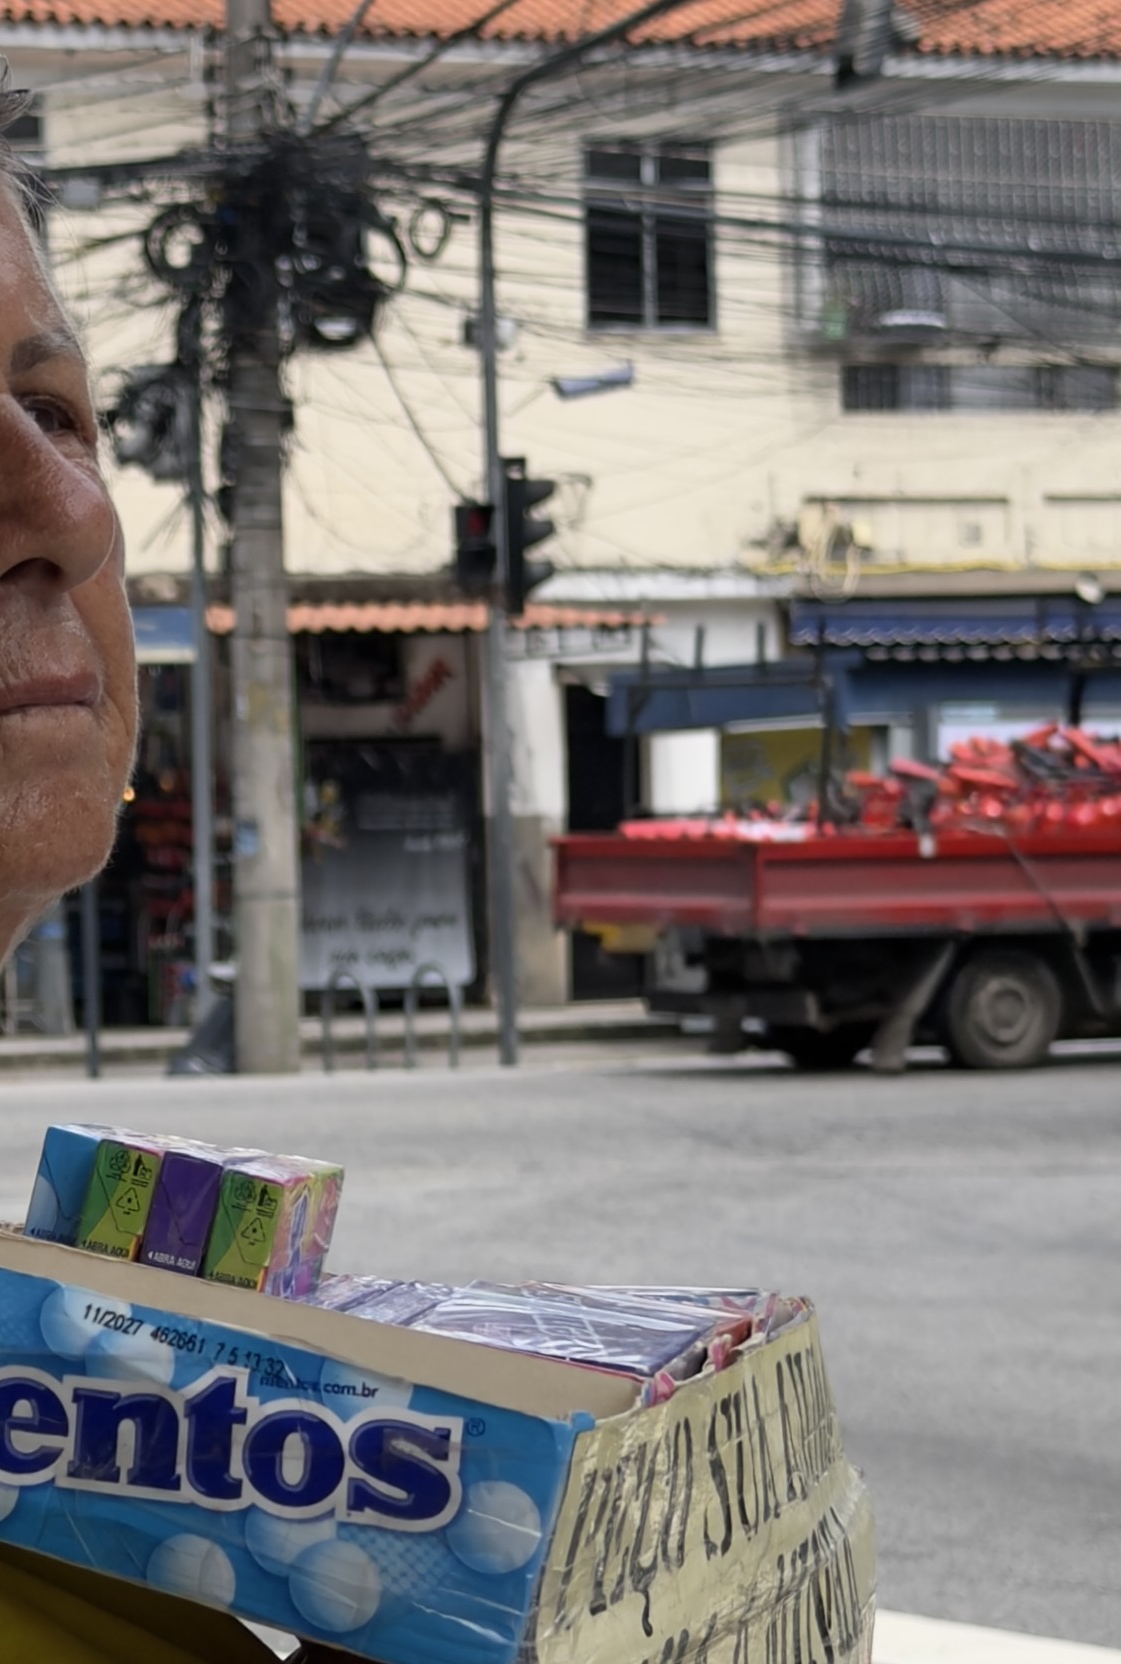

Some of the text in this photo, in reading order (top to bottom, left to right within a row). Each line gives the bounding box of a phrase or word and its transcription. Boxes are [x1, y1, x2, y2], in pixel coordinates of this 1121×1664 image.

[153, 1250, 197, 1271] ABRA AQUI
[83, 1304, 143, 1336] 11/2027
[150, 1325, 206, 1354] 462661
[554, 1417, 692, 1637] PEÇO
[704, 1374, 781, 1561] SUA
